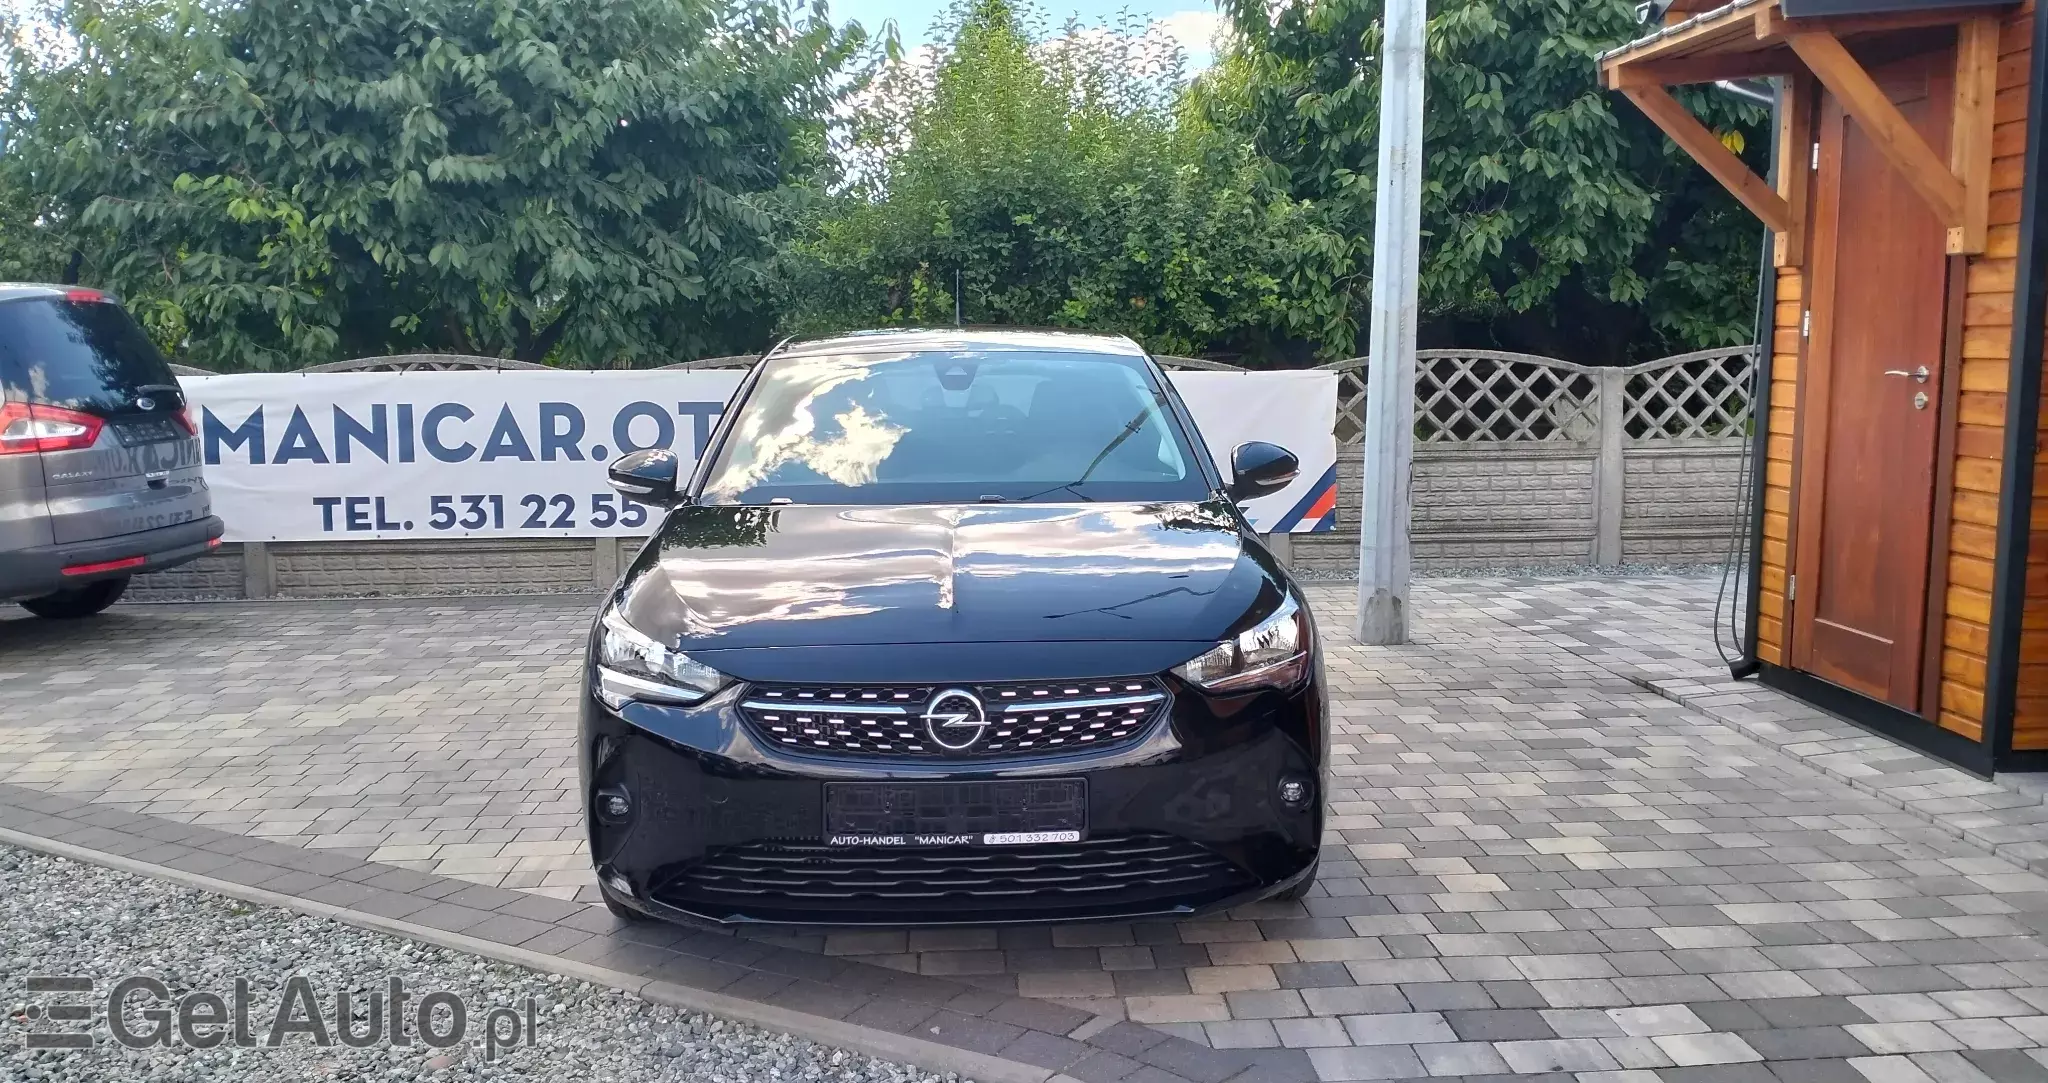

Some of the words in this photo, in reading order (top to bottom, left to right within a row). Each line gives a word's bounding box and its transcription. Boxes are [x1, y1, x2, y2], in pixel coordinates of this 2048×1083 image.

[202, 401, 725, 465] MANICAR.OT
[52, 470, 93, 479] GALAXY
[312, 495, 414, 532] TEL.
[428, 494, 504, 530] 531
[520, 493, 576, 529] 22
[590, 493, 647, 528] 55
[830, 835, 906, 845] AUTO-HANDEL
[915, 835, 973, 844] "MANICAR"
[1000, 834, 1022, 843] 501
[1025, 833, 1049, 842] 332
[1052, 832, 1075, 841] 703
